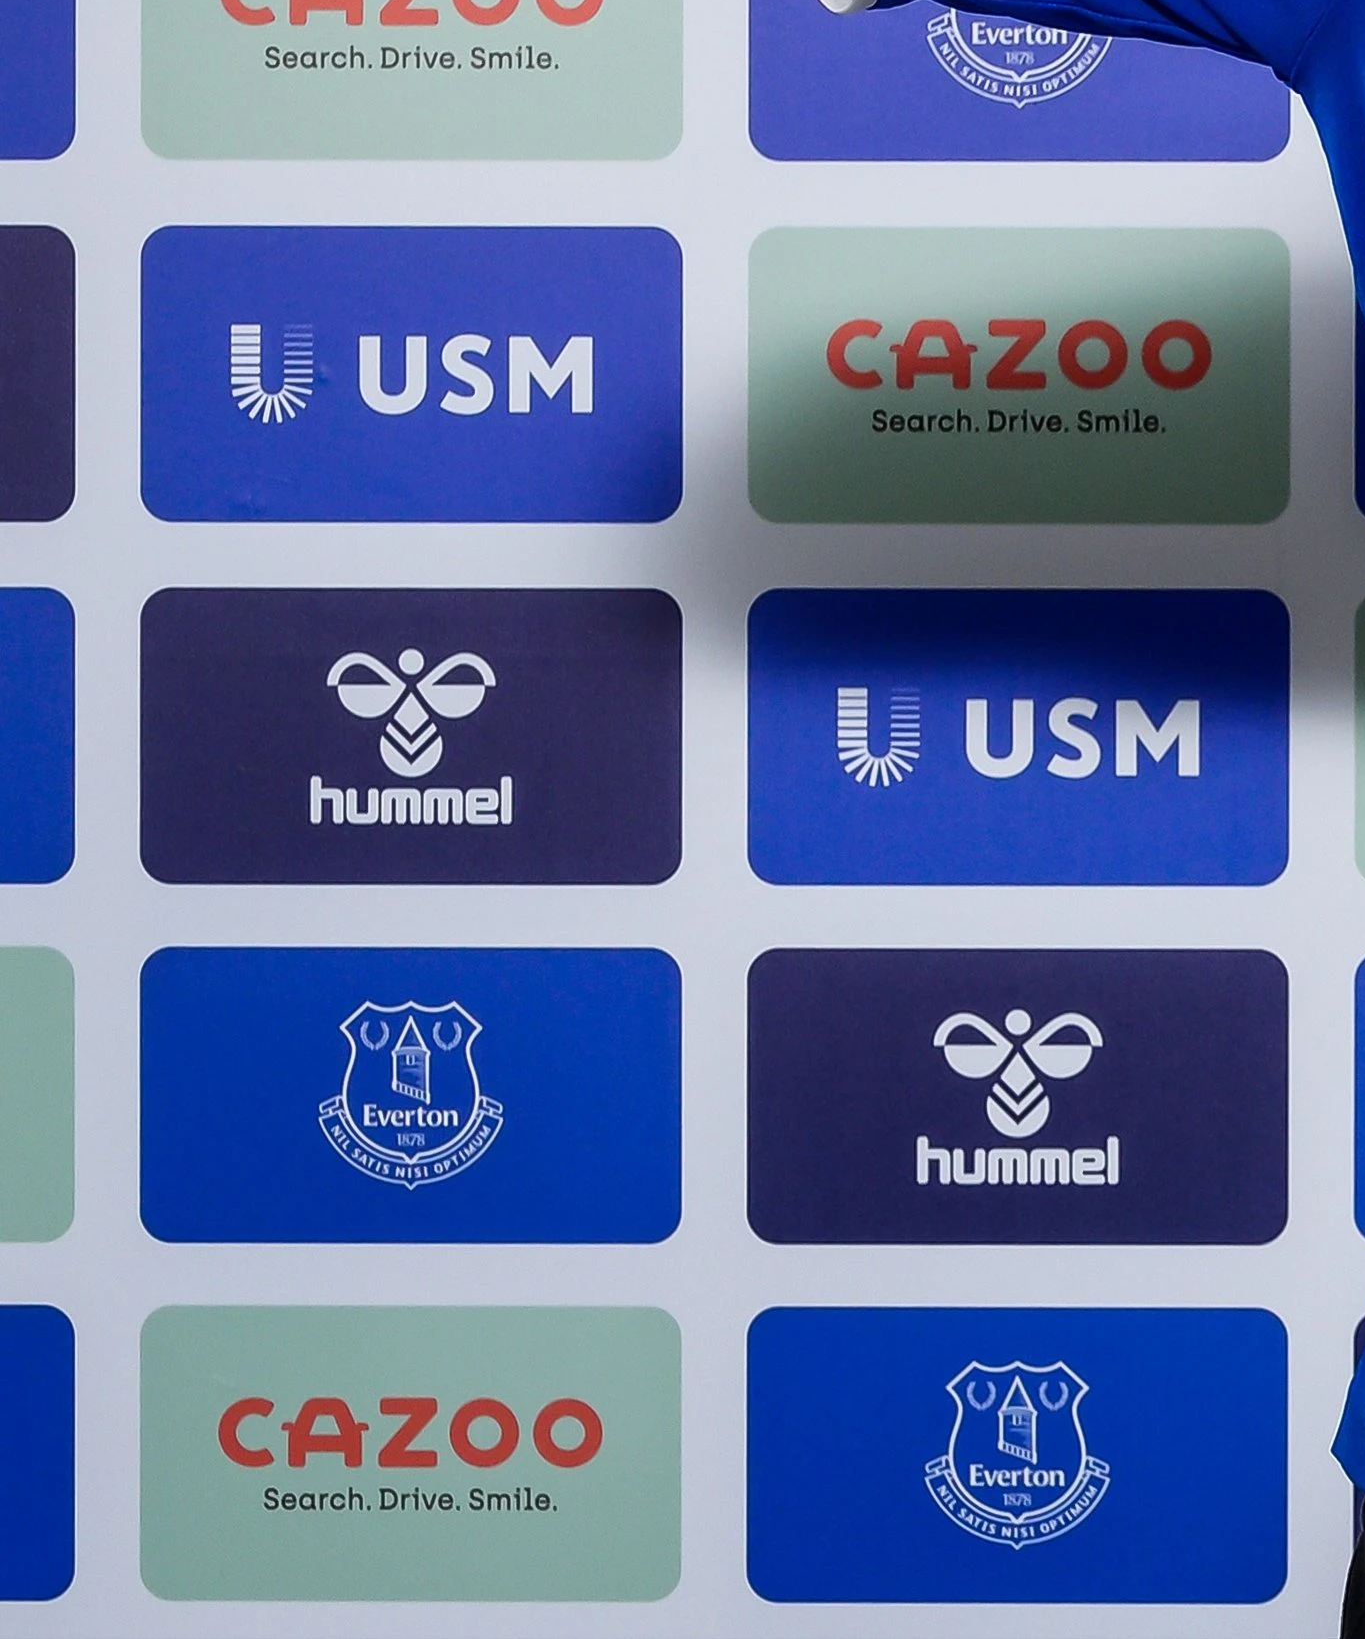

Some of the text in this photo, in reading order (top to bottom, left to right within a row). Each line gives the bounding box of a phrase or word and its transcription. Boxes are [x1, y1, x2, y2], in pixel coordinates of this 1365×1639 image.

[264, 45, 559, 69] Search. Drive. Smile.
[972, 22, 1068, 45] Everton
[939, 42, 1101, 97] NIL SATIS NISI OPTIMUM
[359, 334, 593, 414] USM
[826, 319, 1212, 390] CAZOO
[871, 409, 1166, 433] Search. Drive. Smile.
[966, 698, 1200, 778] USM
[310, 775, 513, 824] hummel
[363, 1104, 459, 1127] Everton
[330, 1124, 492, 1179] NIL SATIS NISI OPTIMUM
[916, 1136, 1119, 1185] hummel
[218, 1397, 604, 1468] CAZOO
[263, 1487, 558, 1511] Search. Drive. Smile.
[969, 1464, 1065, 1487] Everton
[936, 1484, 1098, 1539] NIL SATIS NISI OPTIMUM
